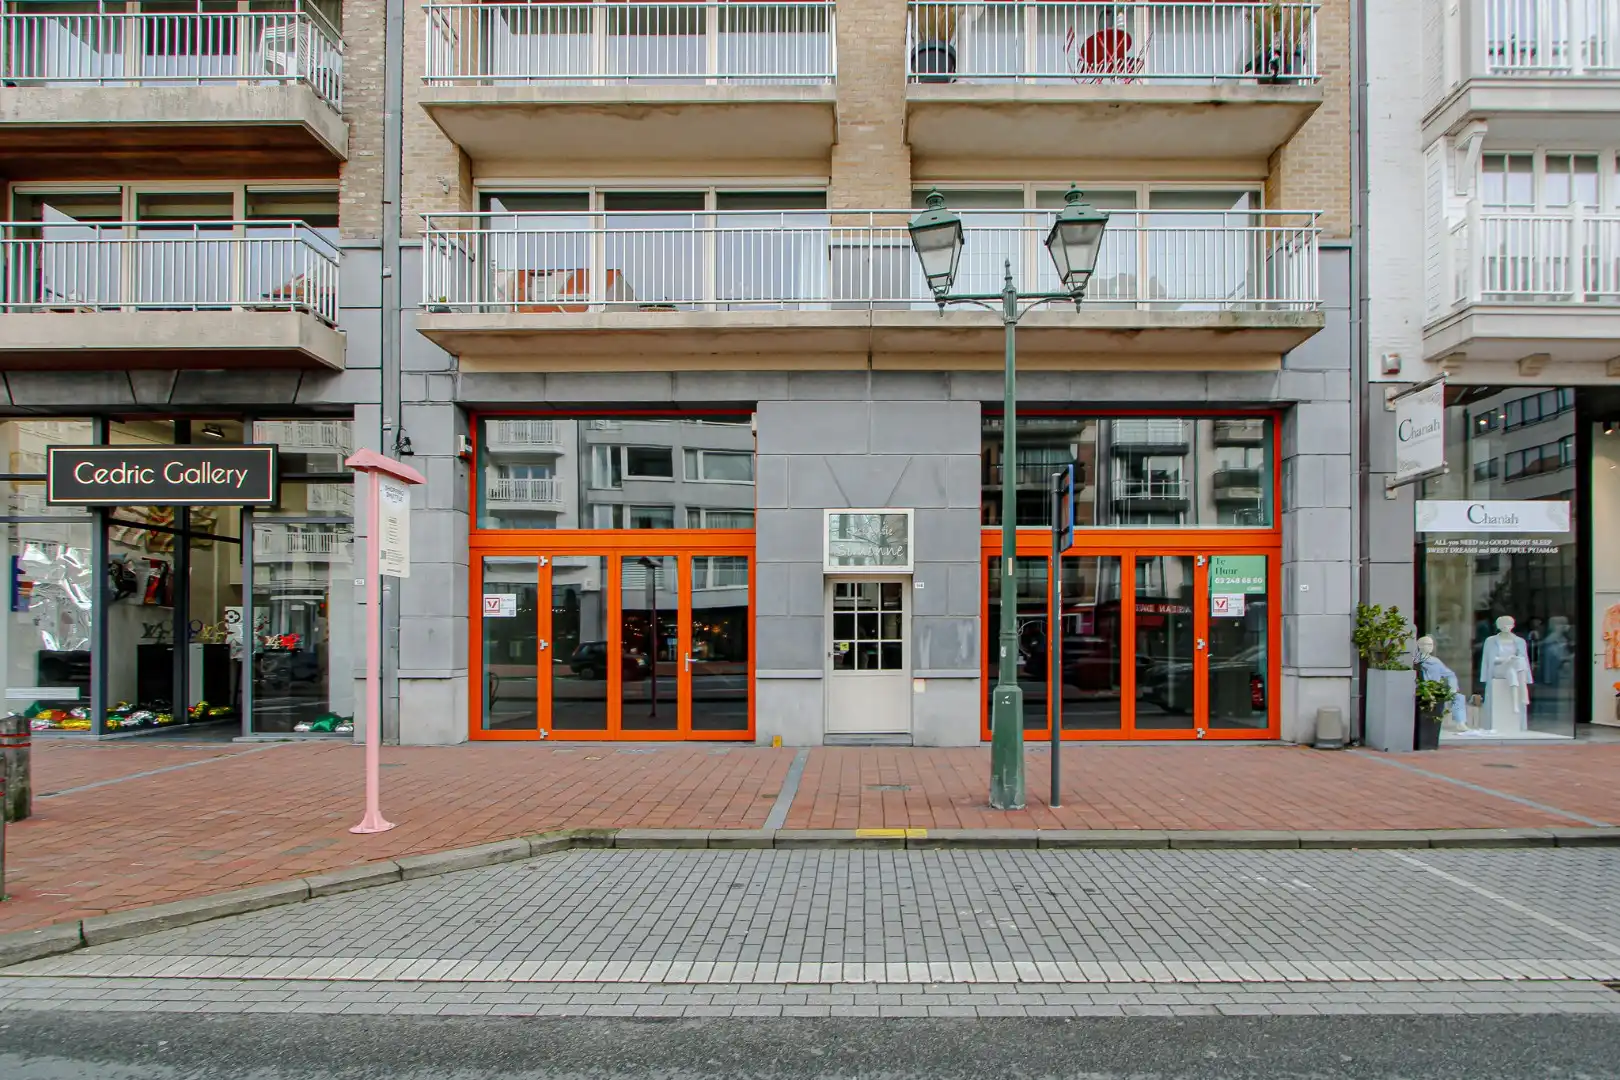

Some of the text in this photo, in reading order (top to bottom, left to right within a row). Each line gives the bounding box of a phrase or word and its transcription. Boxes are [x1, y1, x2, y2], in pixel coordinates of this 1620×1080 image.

[1398, 418, 1441, 442] Chanah
[74, 461, 248, 488] Cedric Gallery
[1466, 503, 1520, 525] Chanah
